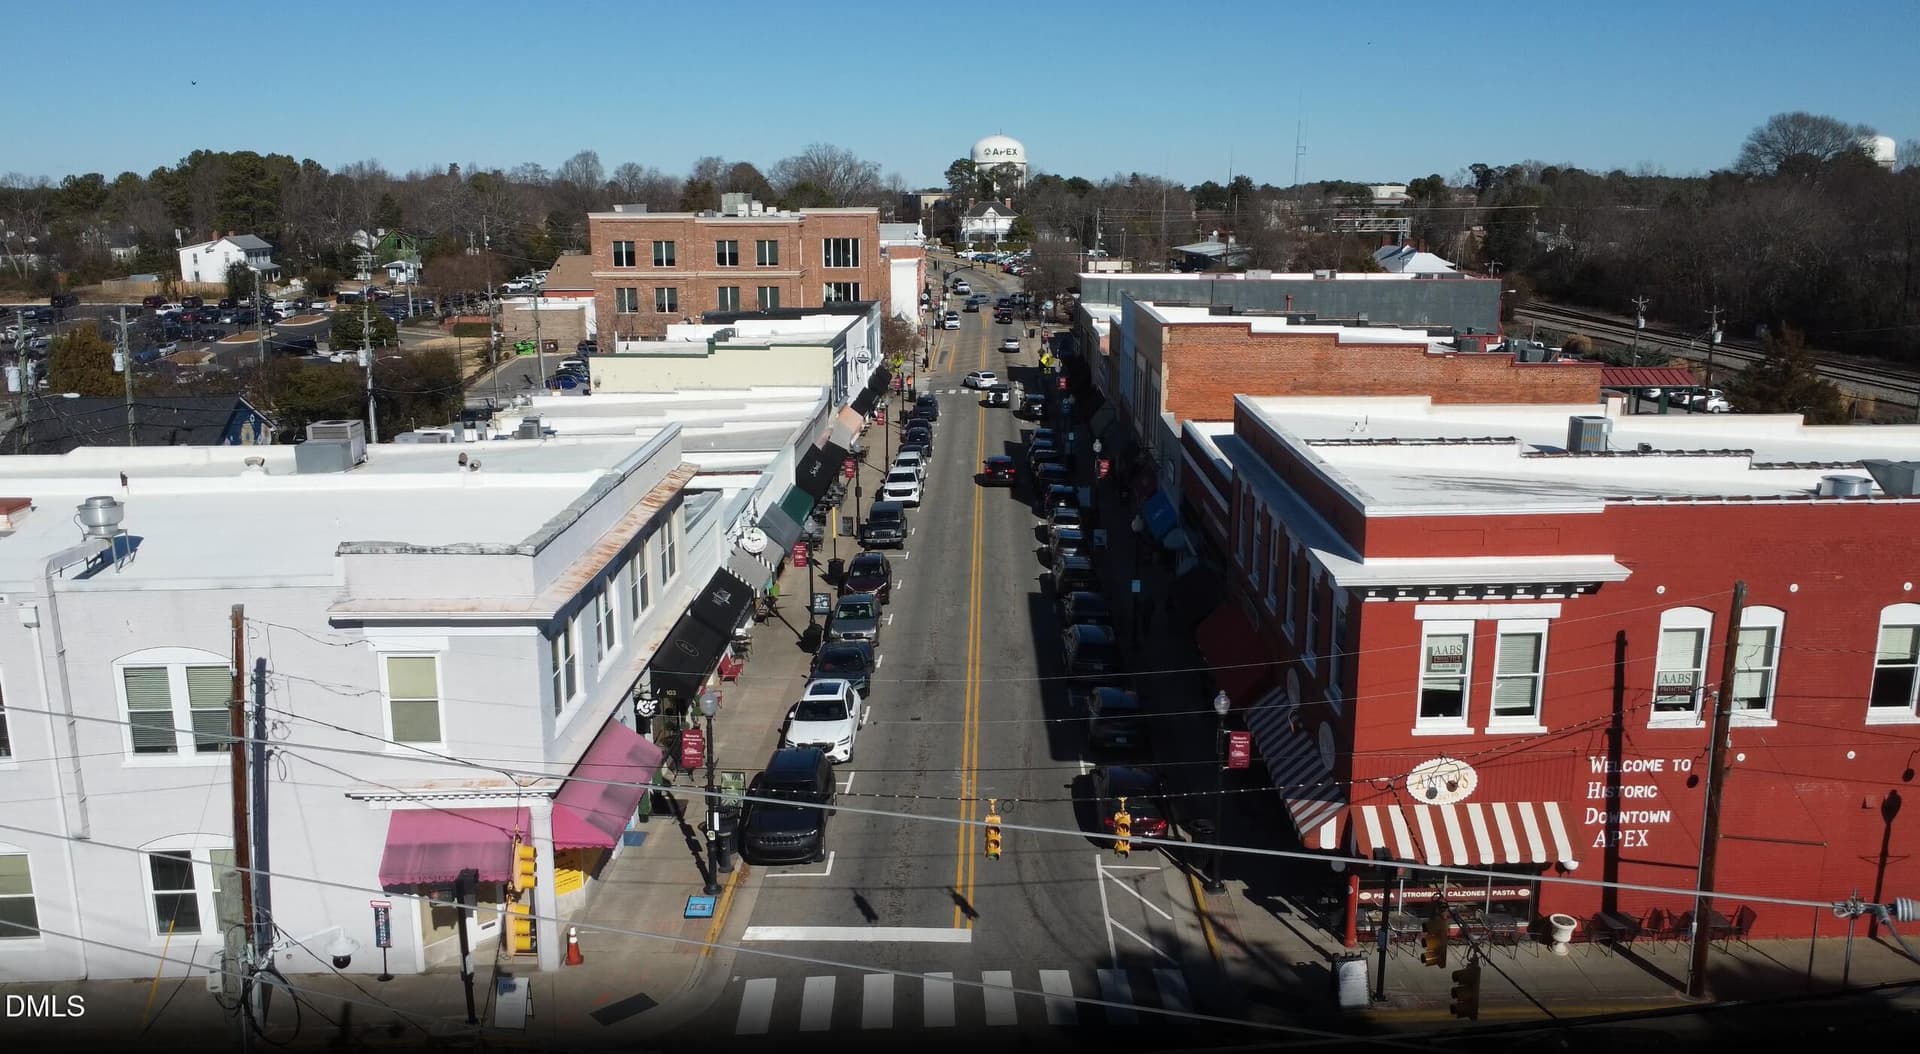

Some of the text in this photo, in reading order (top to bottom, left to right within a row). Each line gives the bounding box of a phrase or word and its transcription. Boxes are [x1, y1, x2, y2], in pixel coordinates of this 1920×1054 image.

[992, 148, 1018, 156] APEX
[1433, 644, 1463, 655] AABS
[1661, 673, 1691, 684] AABS
[1592, 829, 1649, 848] APEX
